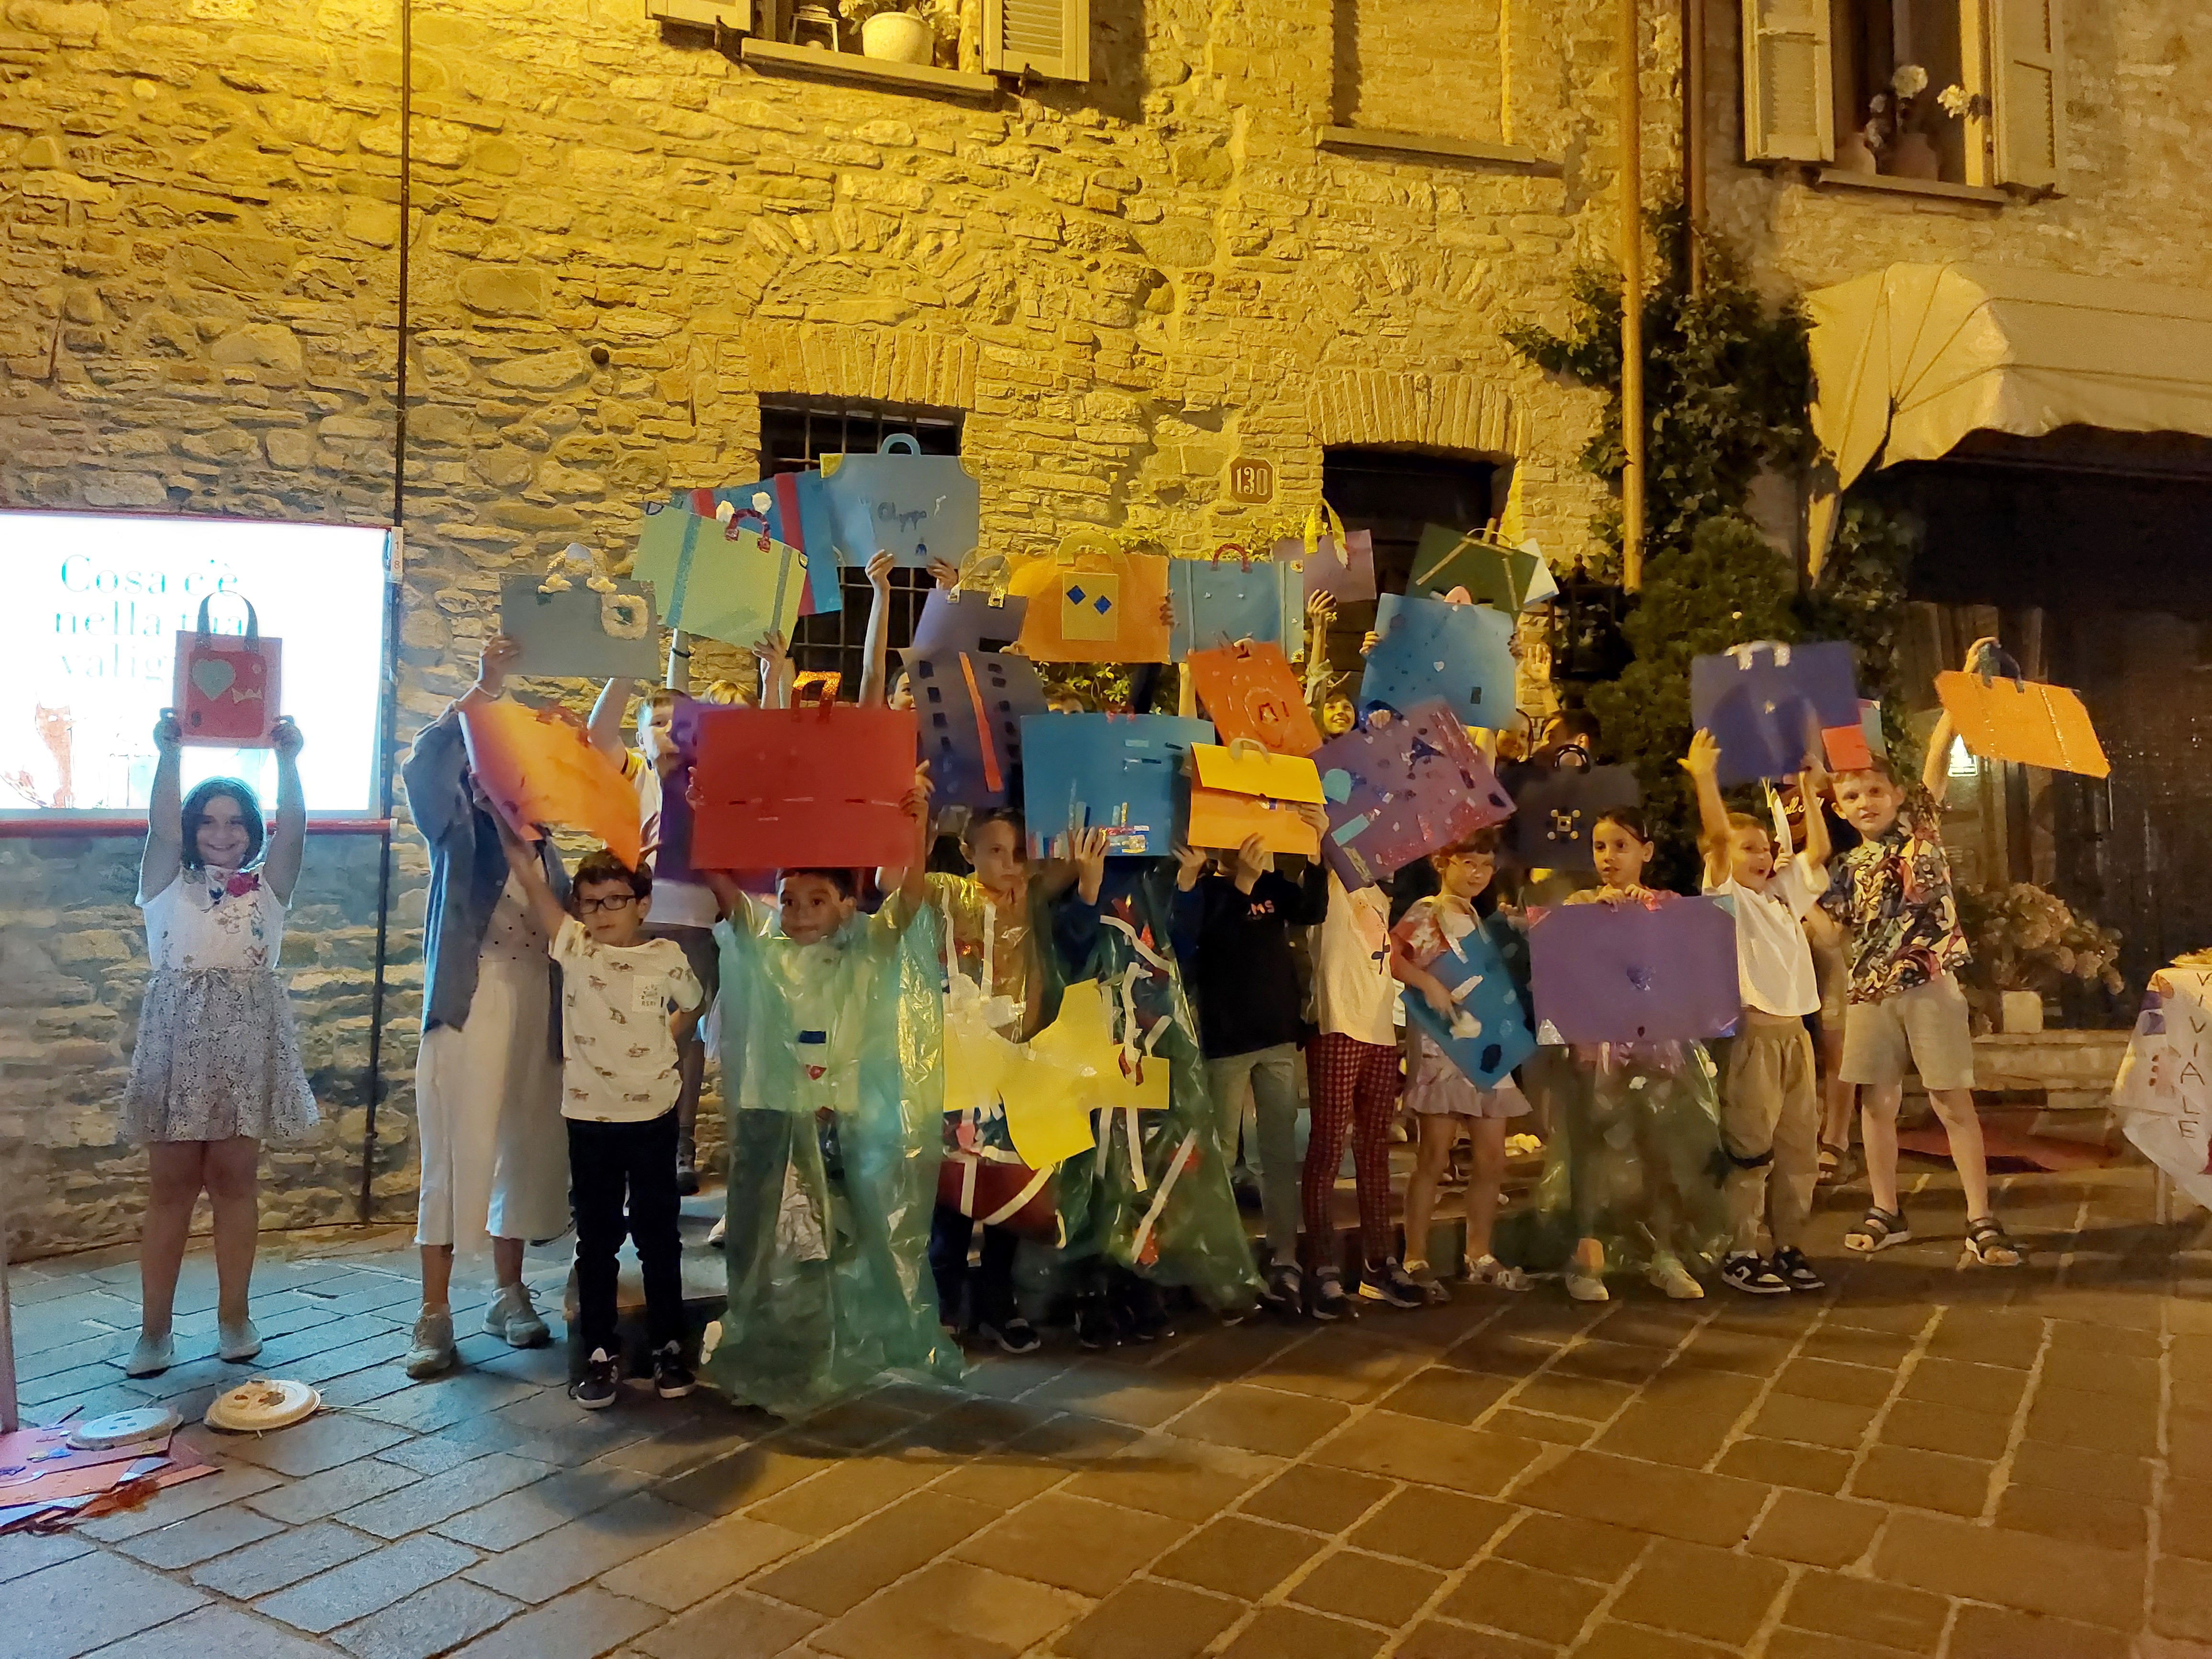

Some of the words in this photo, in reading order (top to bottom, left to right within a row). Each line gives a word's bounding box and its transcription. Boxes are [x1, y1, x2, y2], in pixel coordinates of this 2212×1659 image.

[1236, 466, 1268, 496] 130
[61, 554, 168, 595] Cosa
[53, 599, 166, 636] nella
[58, 642, 173, 691] valig
